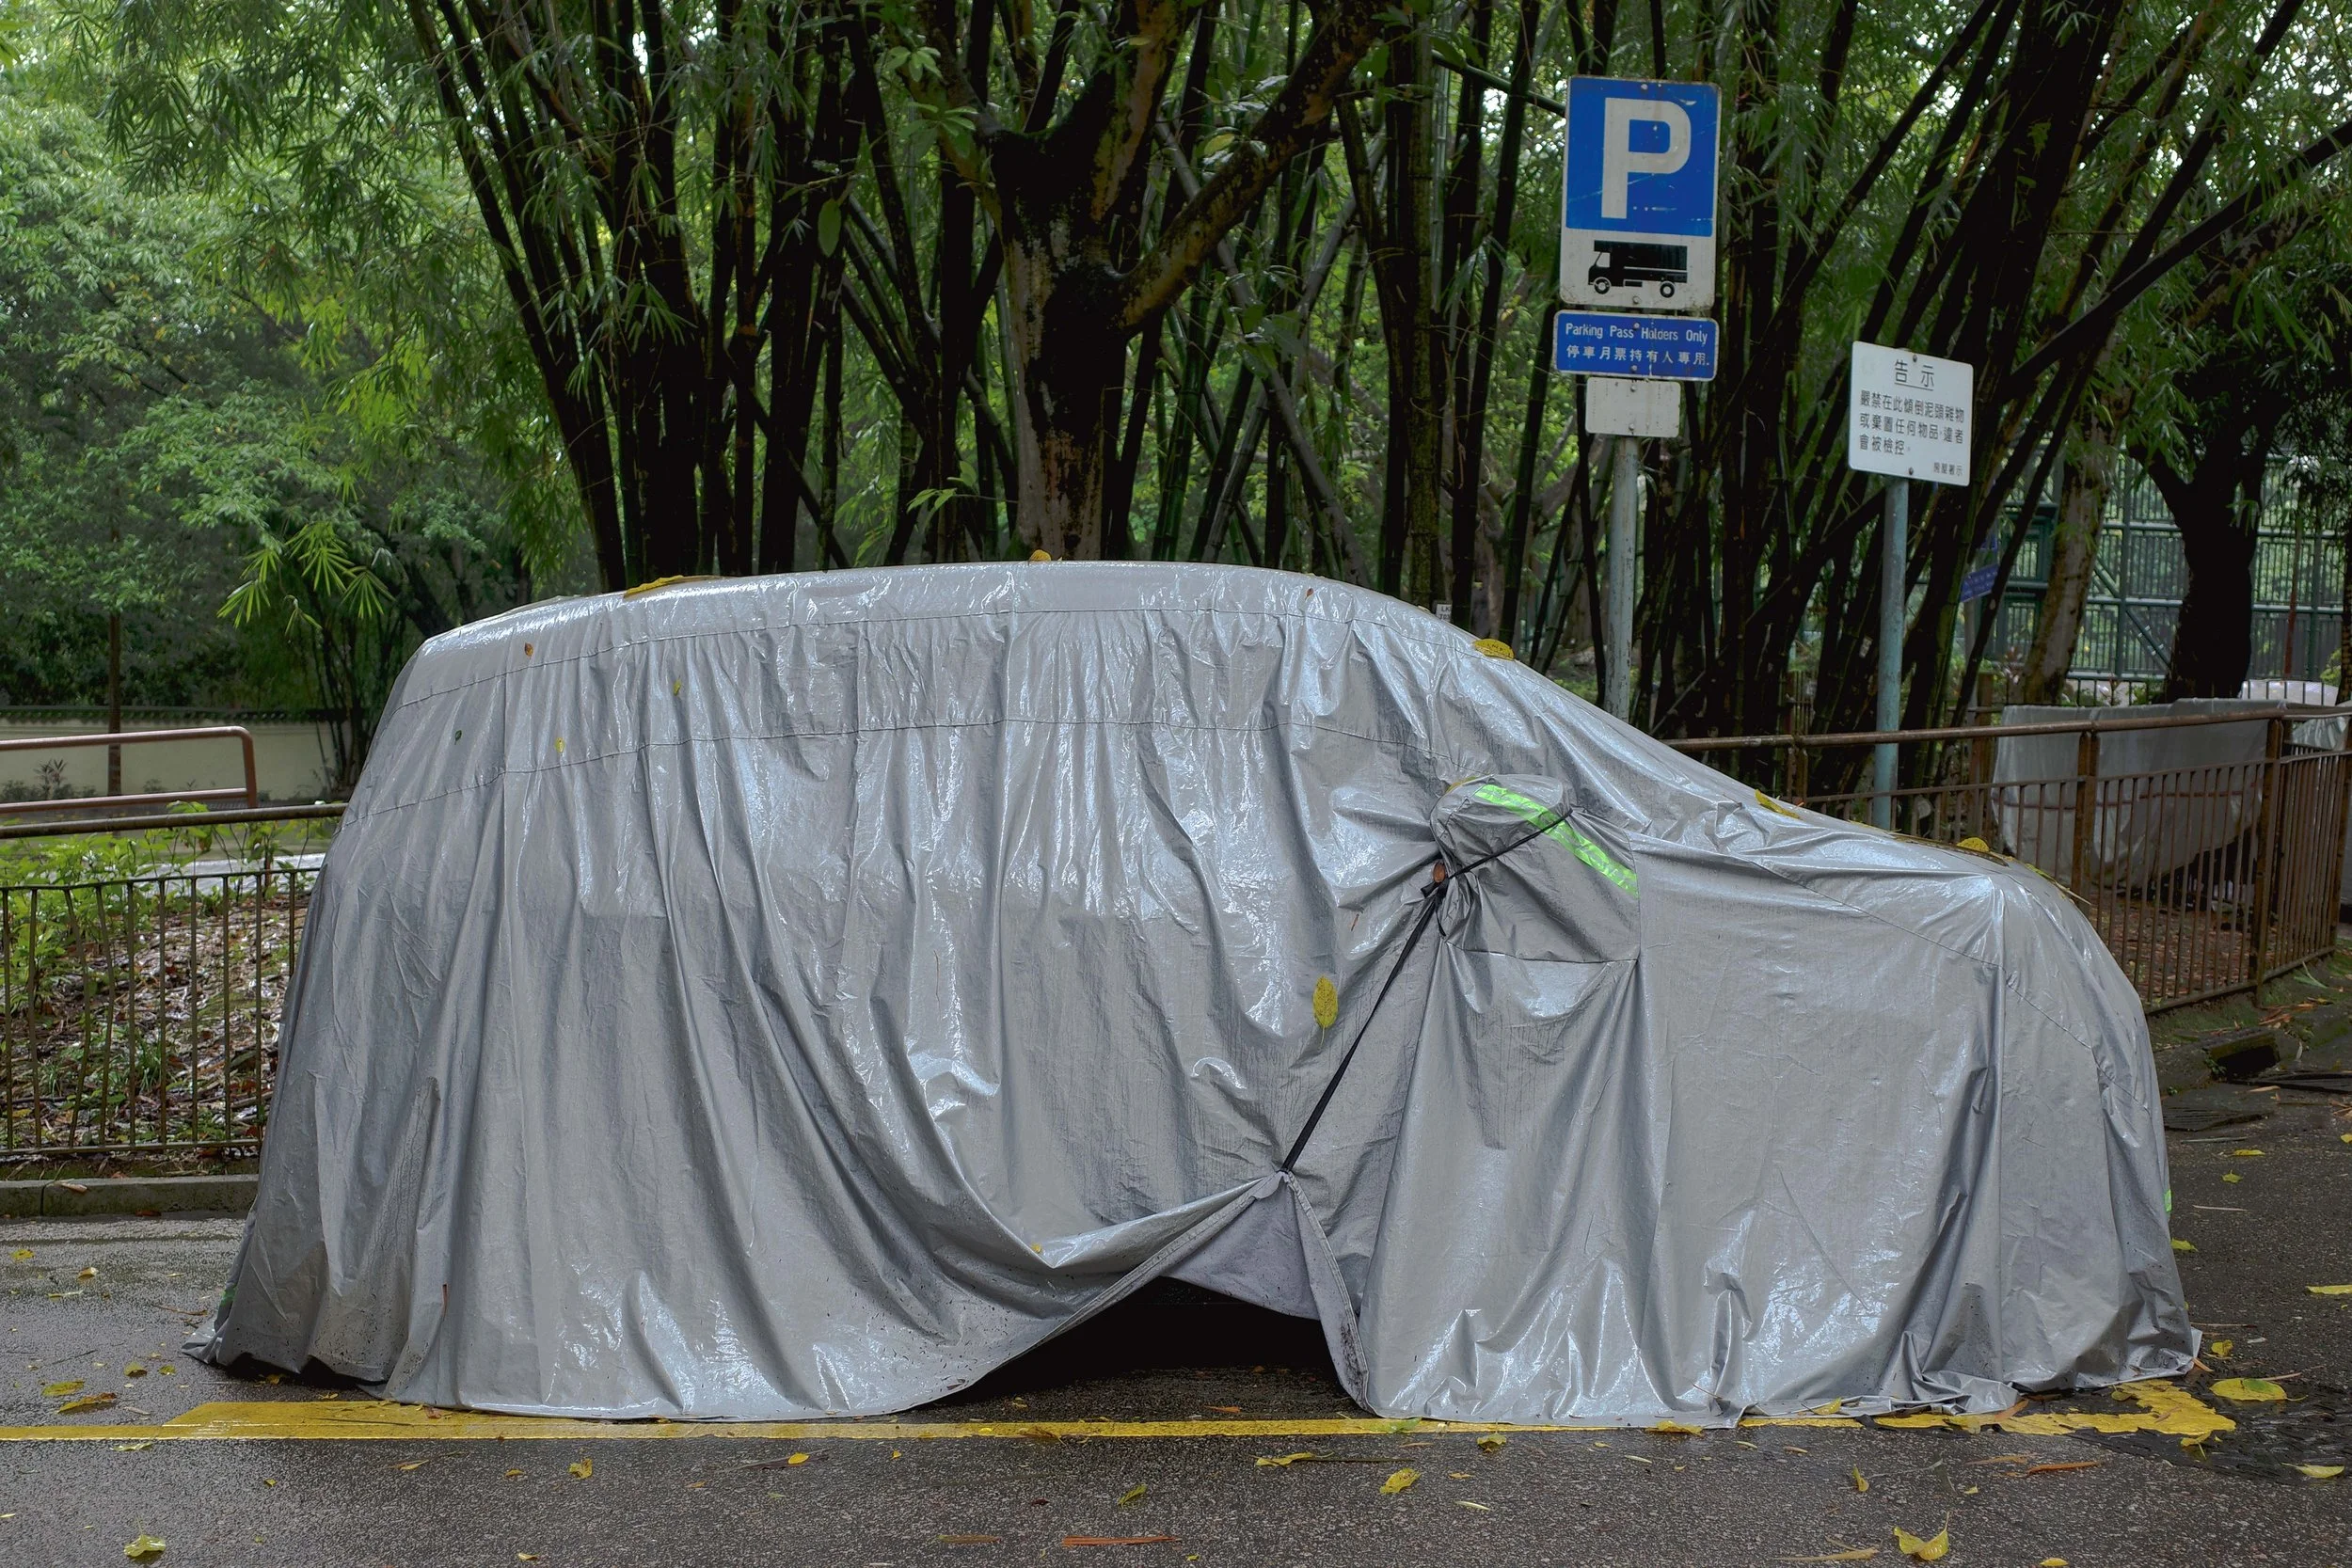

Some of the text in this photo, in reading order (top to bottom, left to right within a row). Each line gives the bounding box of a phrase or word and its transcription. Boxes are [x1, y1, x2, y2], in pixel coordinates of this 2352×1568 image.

[1601, 98, 1692, 219] P
[1565, 323, 1708, 345] Parking Pass Holders Only
[1895, 359, 1934, 388] 告示
